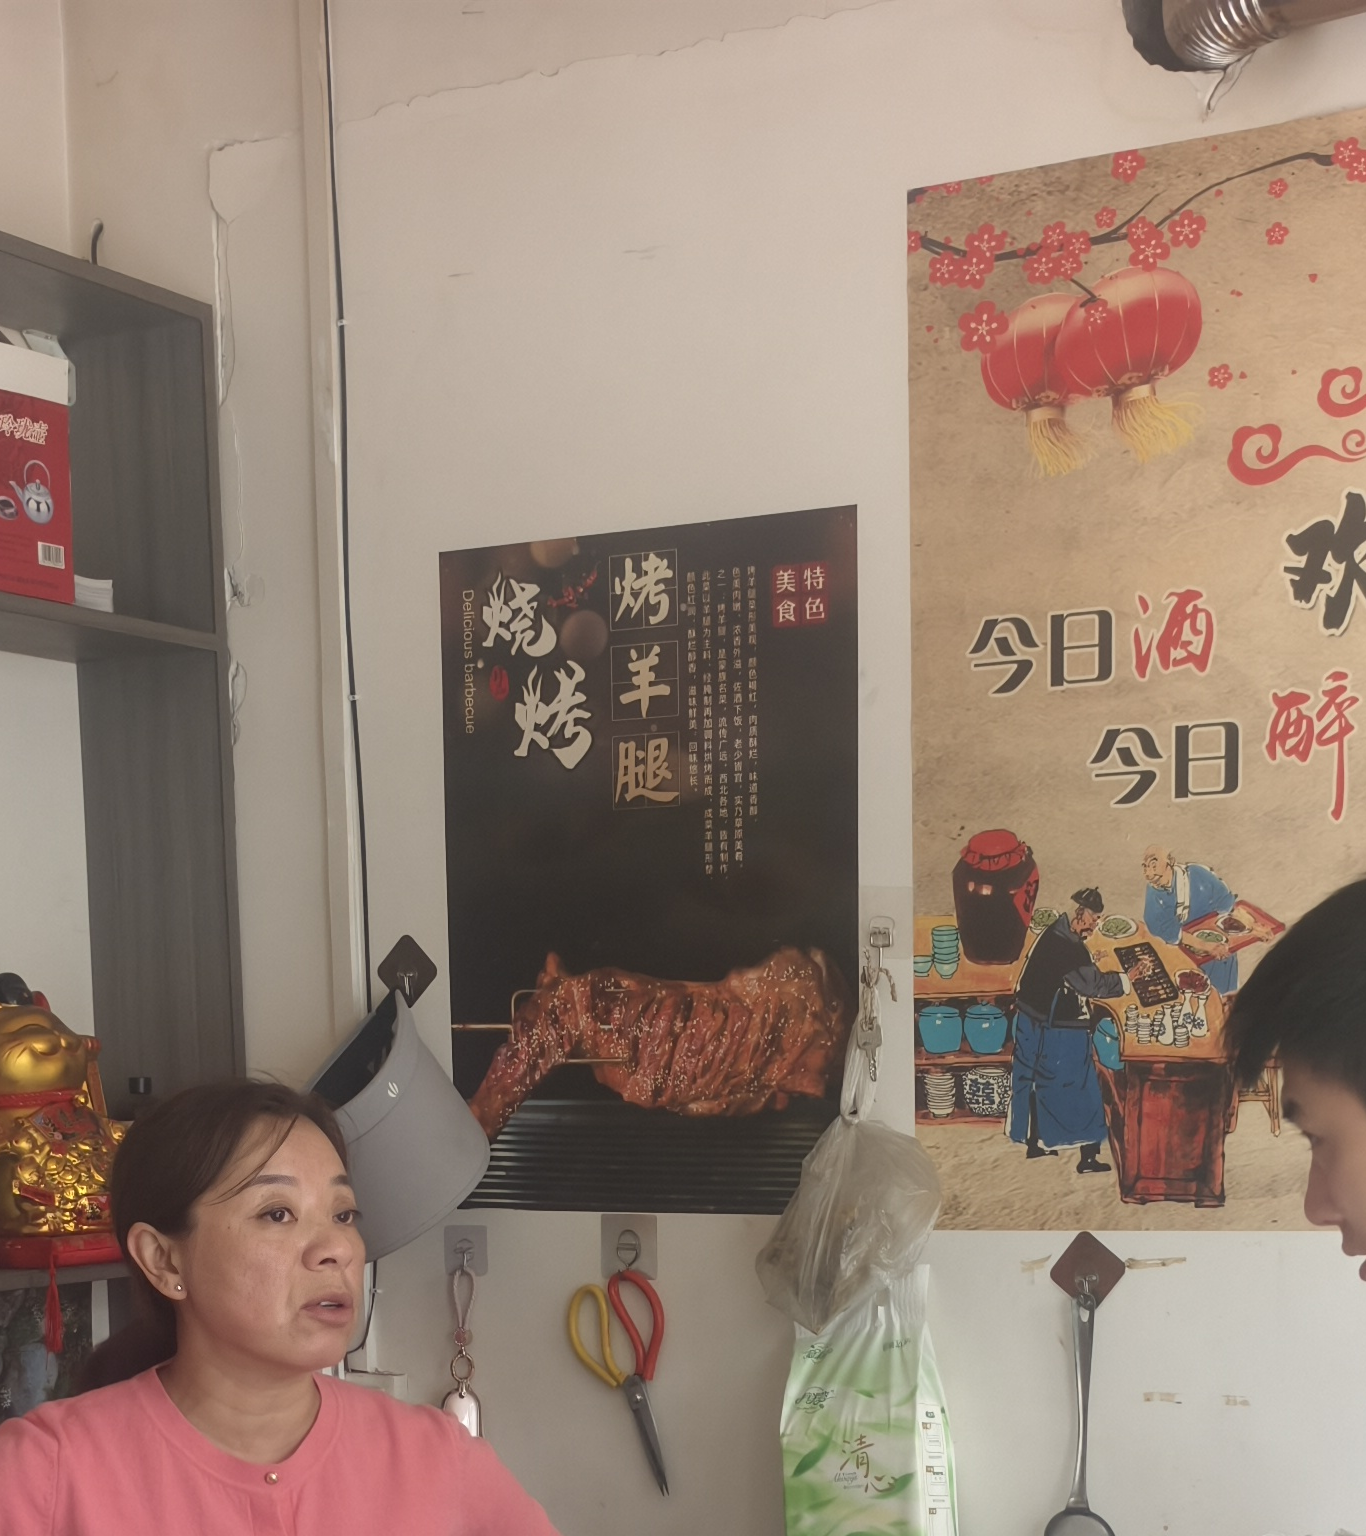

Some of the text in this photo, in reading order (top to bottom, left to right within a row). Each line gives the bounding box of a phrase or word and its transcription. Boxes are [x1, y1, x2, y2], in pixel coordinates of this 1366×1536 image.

[462, 589, 475, 734] Delicious barbecue
[481, 570, 593, 770] 烧烤
[612, 551, 681, 805] 烤羊腿
[968, 589, 1216, 696] 今日酒
[1089, 671, 1360, 822] 今日醉
[839, 1433, 899, 1494] 清心
